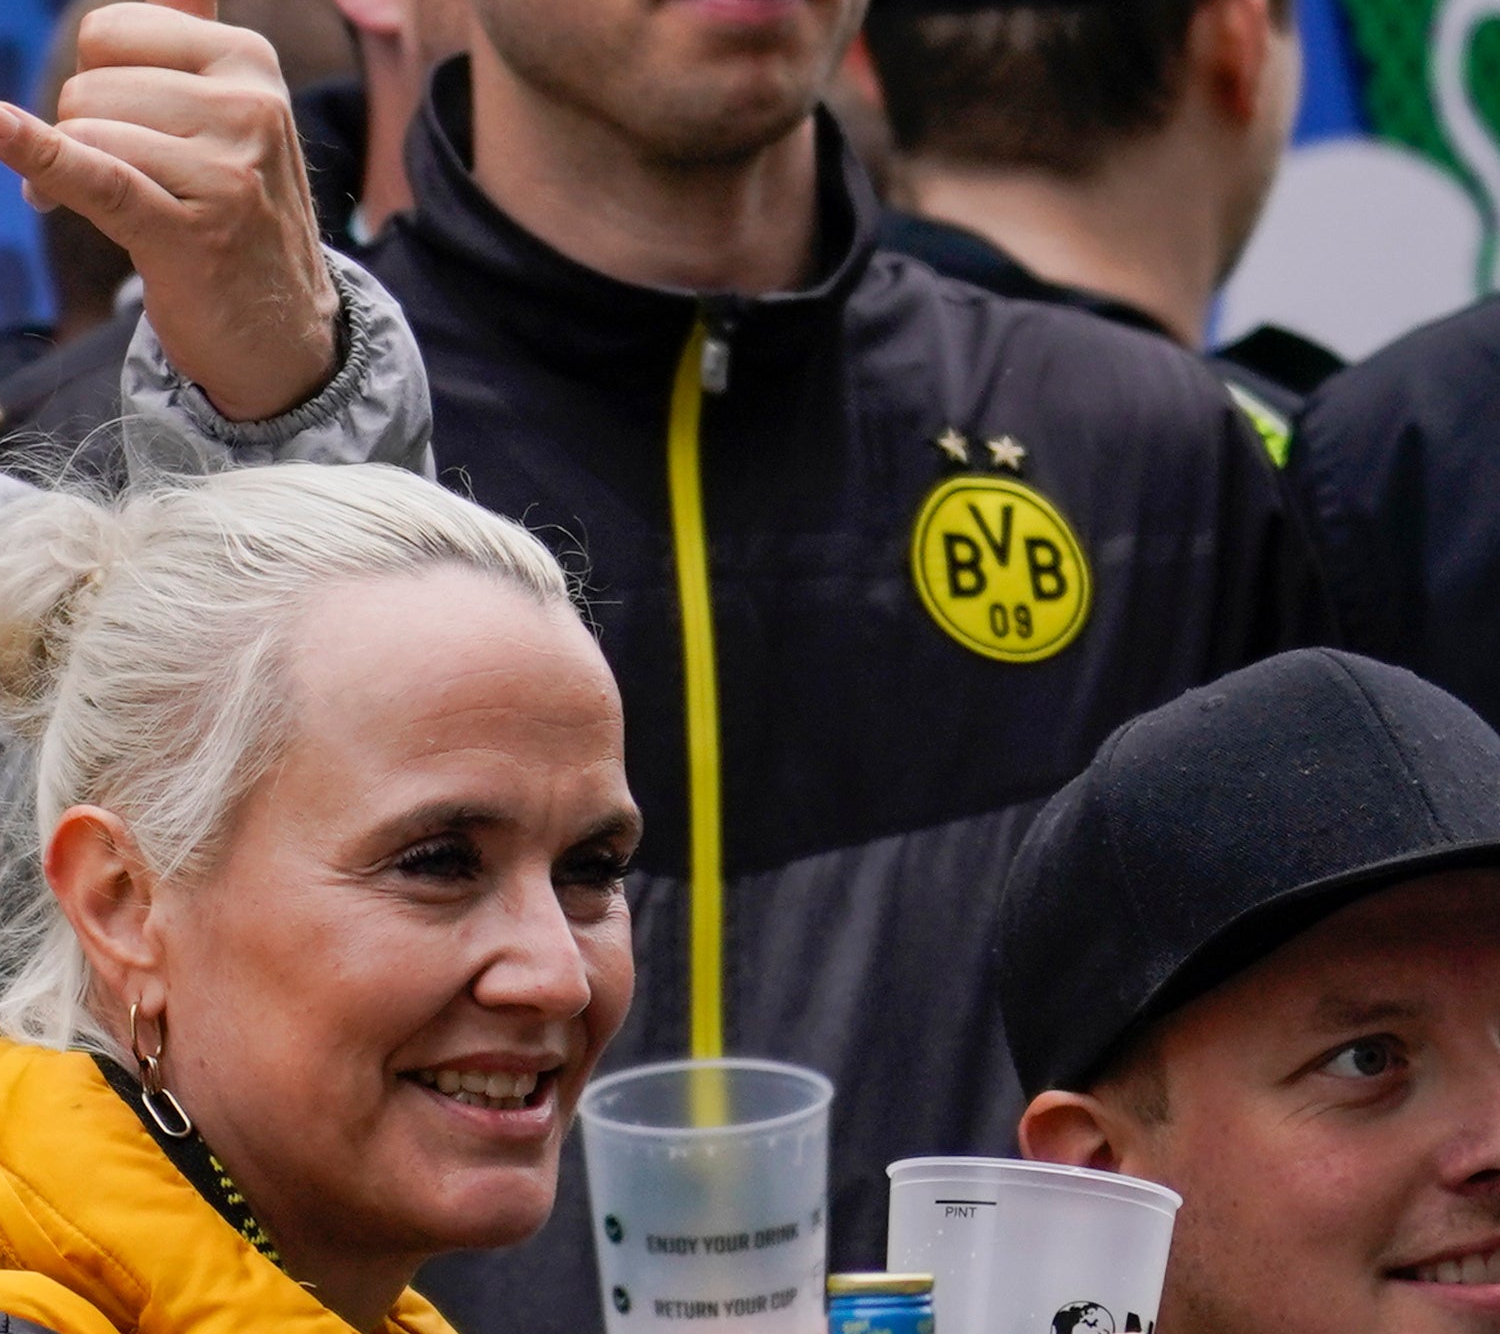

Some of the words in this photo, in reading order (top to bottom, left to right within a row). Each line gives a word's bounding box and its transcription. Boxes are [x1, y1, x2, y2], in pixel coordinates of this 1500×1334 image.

[942, 501, 1069, 603] BVB
[988, 602, 1035, 639] 09
[944, 1206, 978, 1219] PINT
[646, 1233, 699, 1256] ENJOY
[703, 1232, 751, 1255] YOUR
[754, 1222, 799, 1250] DRINK
[654, 1298, 719, 1320] RETURN
[723, 1294, 768, 1317] YOUR
[770, 1286, 798, 1311] CUP
